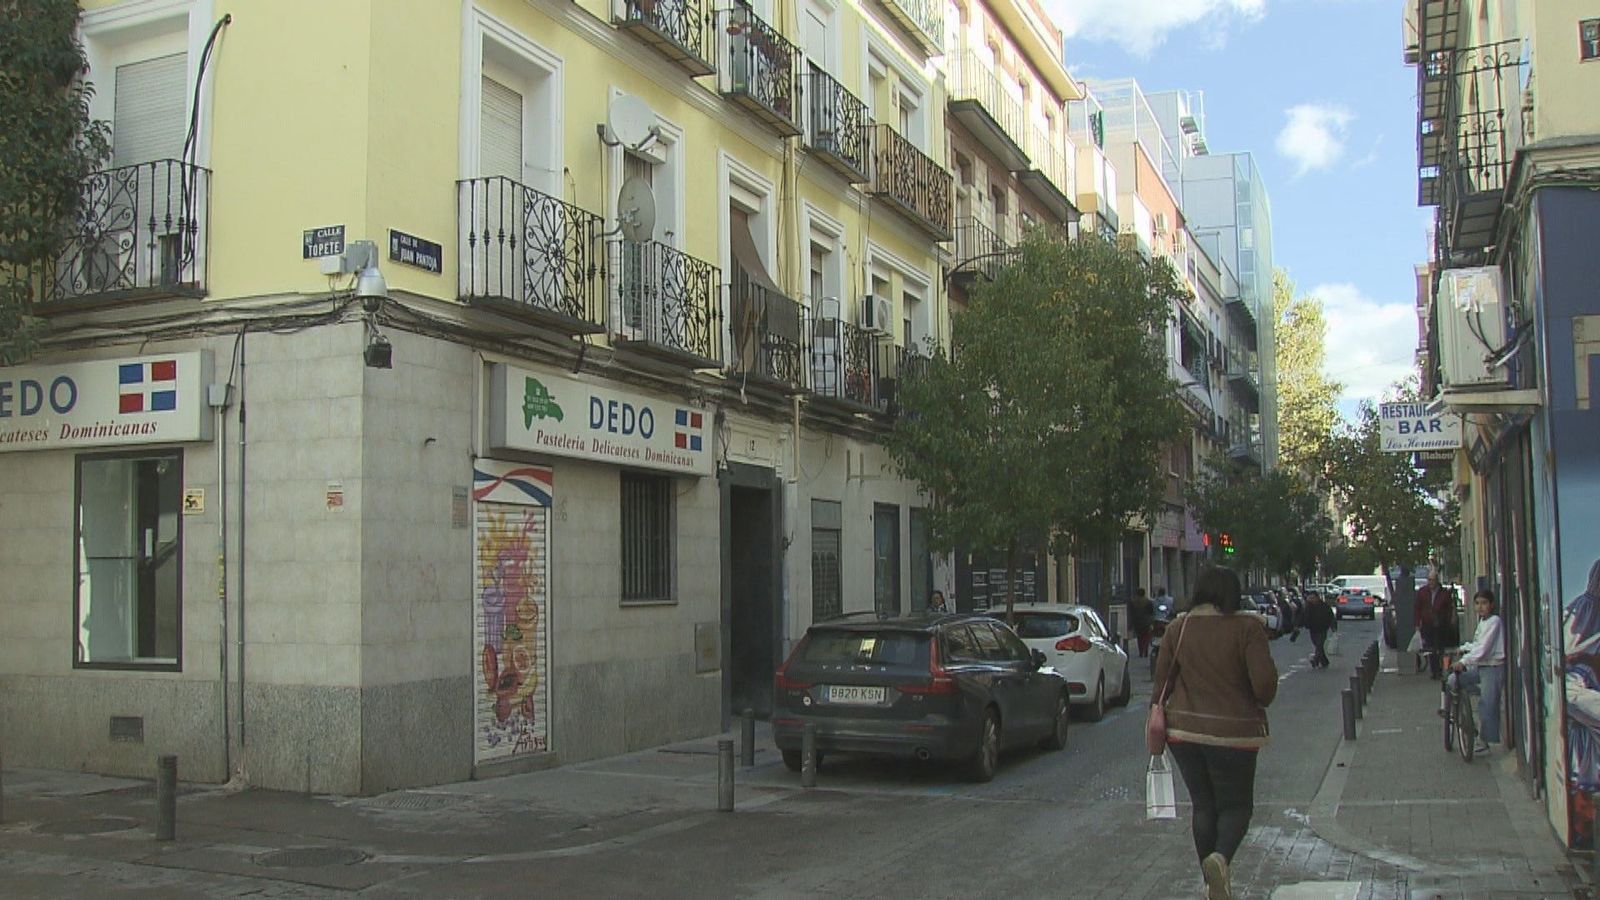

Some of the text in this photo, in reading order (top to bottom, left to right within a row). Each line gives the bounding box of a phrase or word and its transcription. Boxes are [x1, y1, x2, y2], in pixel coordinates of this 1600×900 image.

[317, 227, 342, 238] CALLE
[308, 241, 341, 257] TOPETE
[589, 395, 655, 440] DEDO
[59, 420, 158, 440] Dominicanas
[1399, 420, 1443, 434] BAR
[536, 429, 695, 468] Pasteleria Delicateses Dominicanas
[831, 687, 858, 699] 9820
[860, 688, 883, 700] KSN
